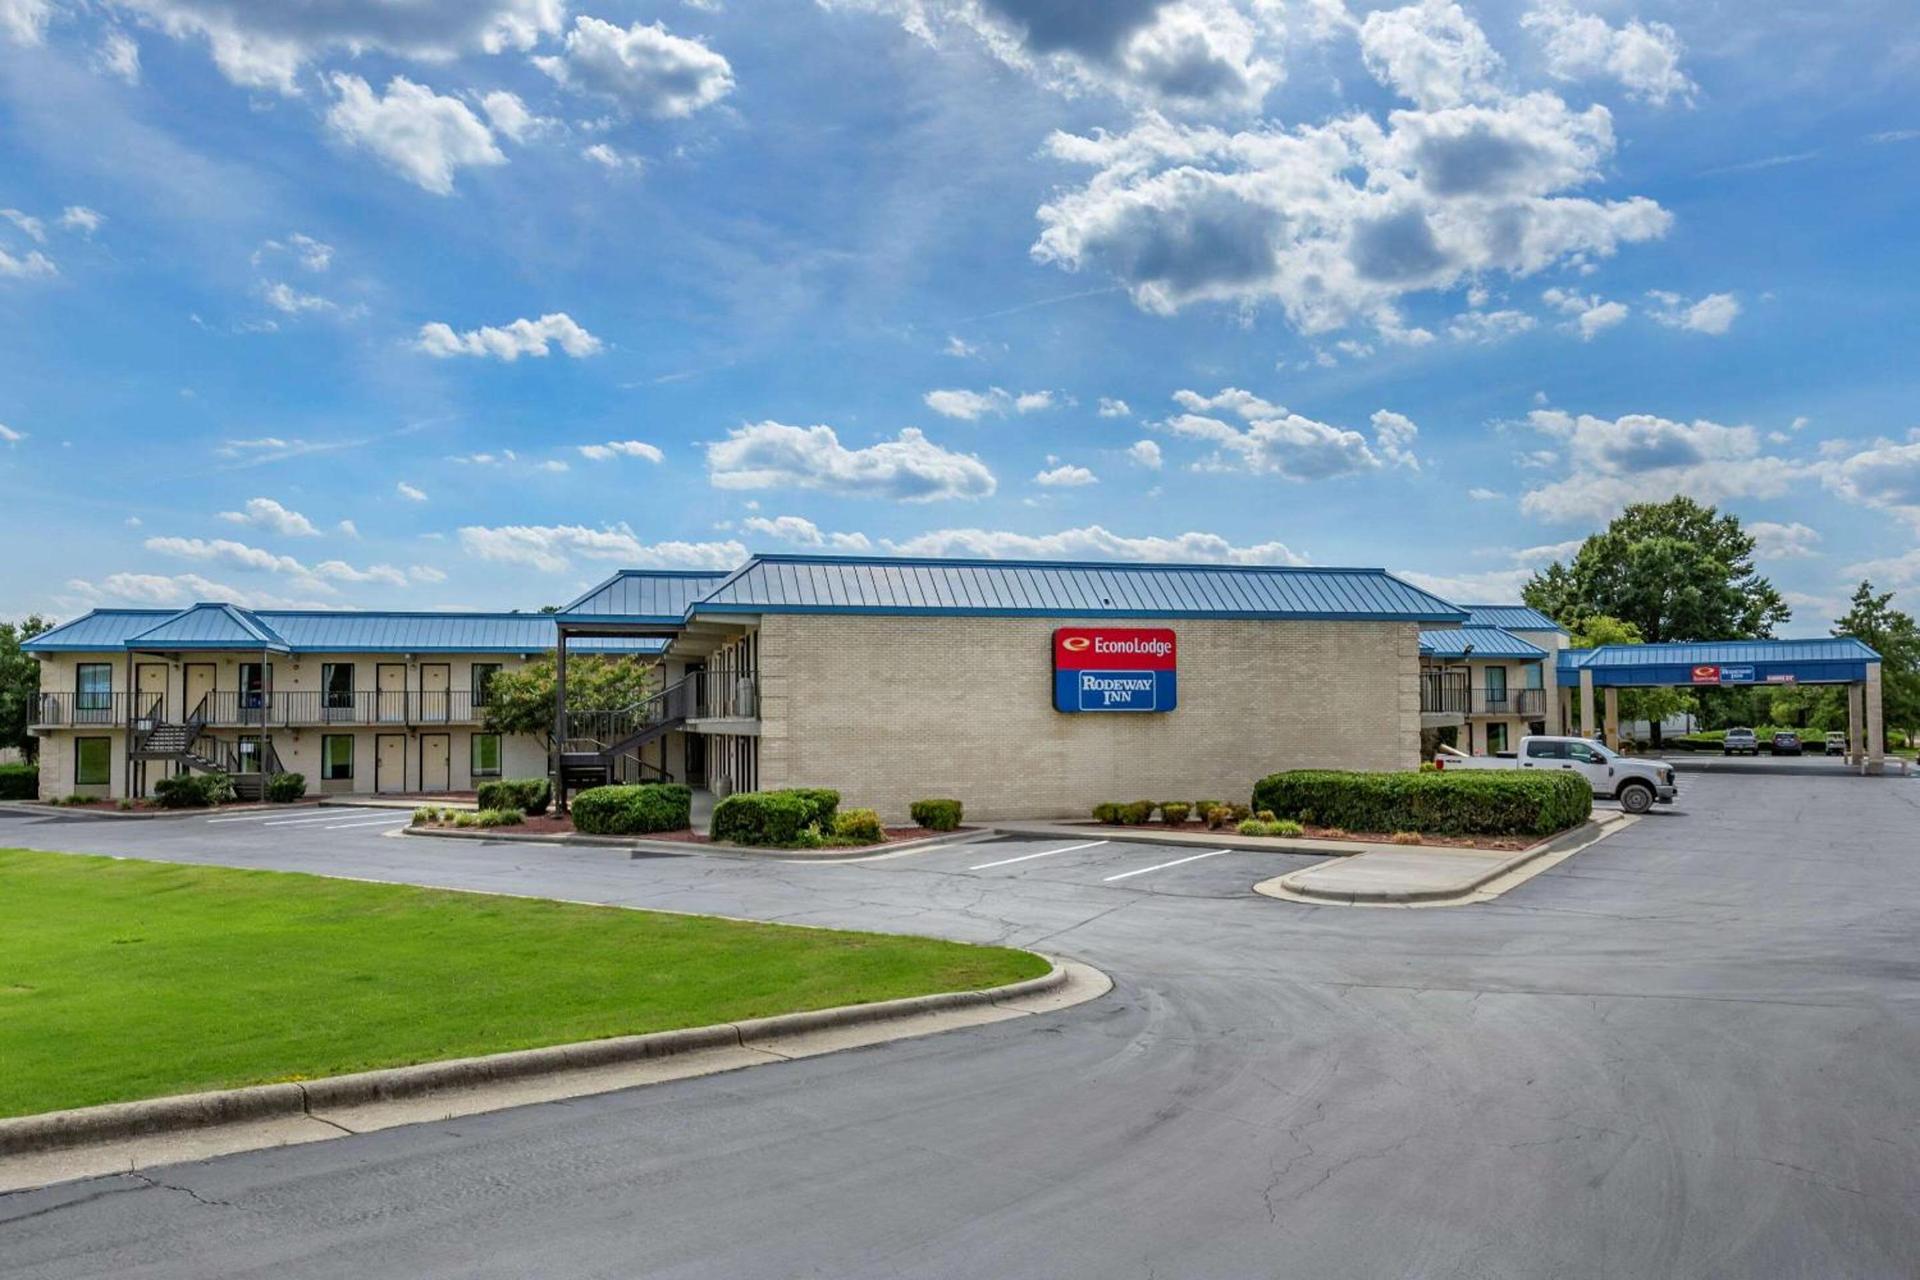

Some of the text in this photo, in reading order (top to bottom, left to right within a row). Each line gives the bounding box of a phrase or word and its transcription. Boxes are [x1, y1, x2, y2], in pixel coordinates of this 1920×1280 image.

[1094, 637, 1172, 657] EconoLodge
[1081, 675, 1153, 691] RODEWAY
[1103, 691, 1132, 705] INN
